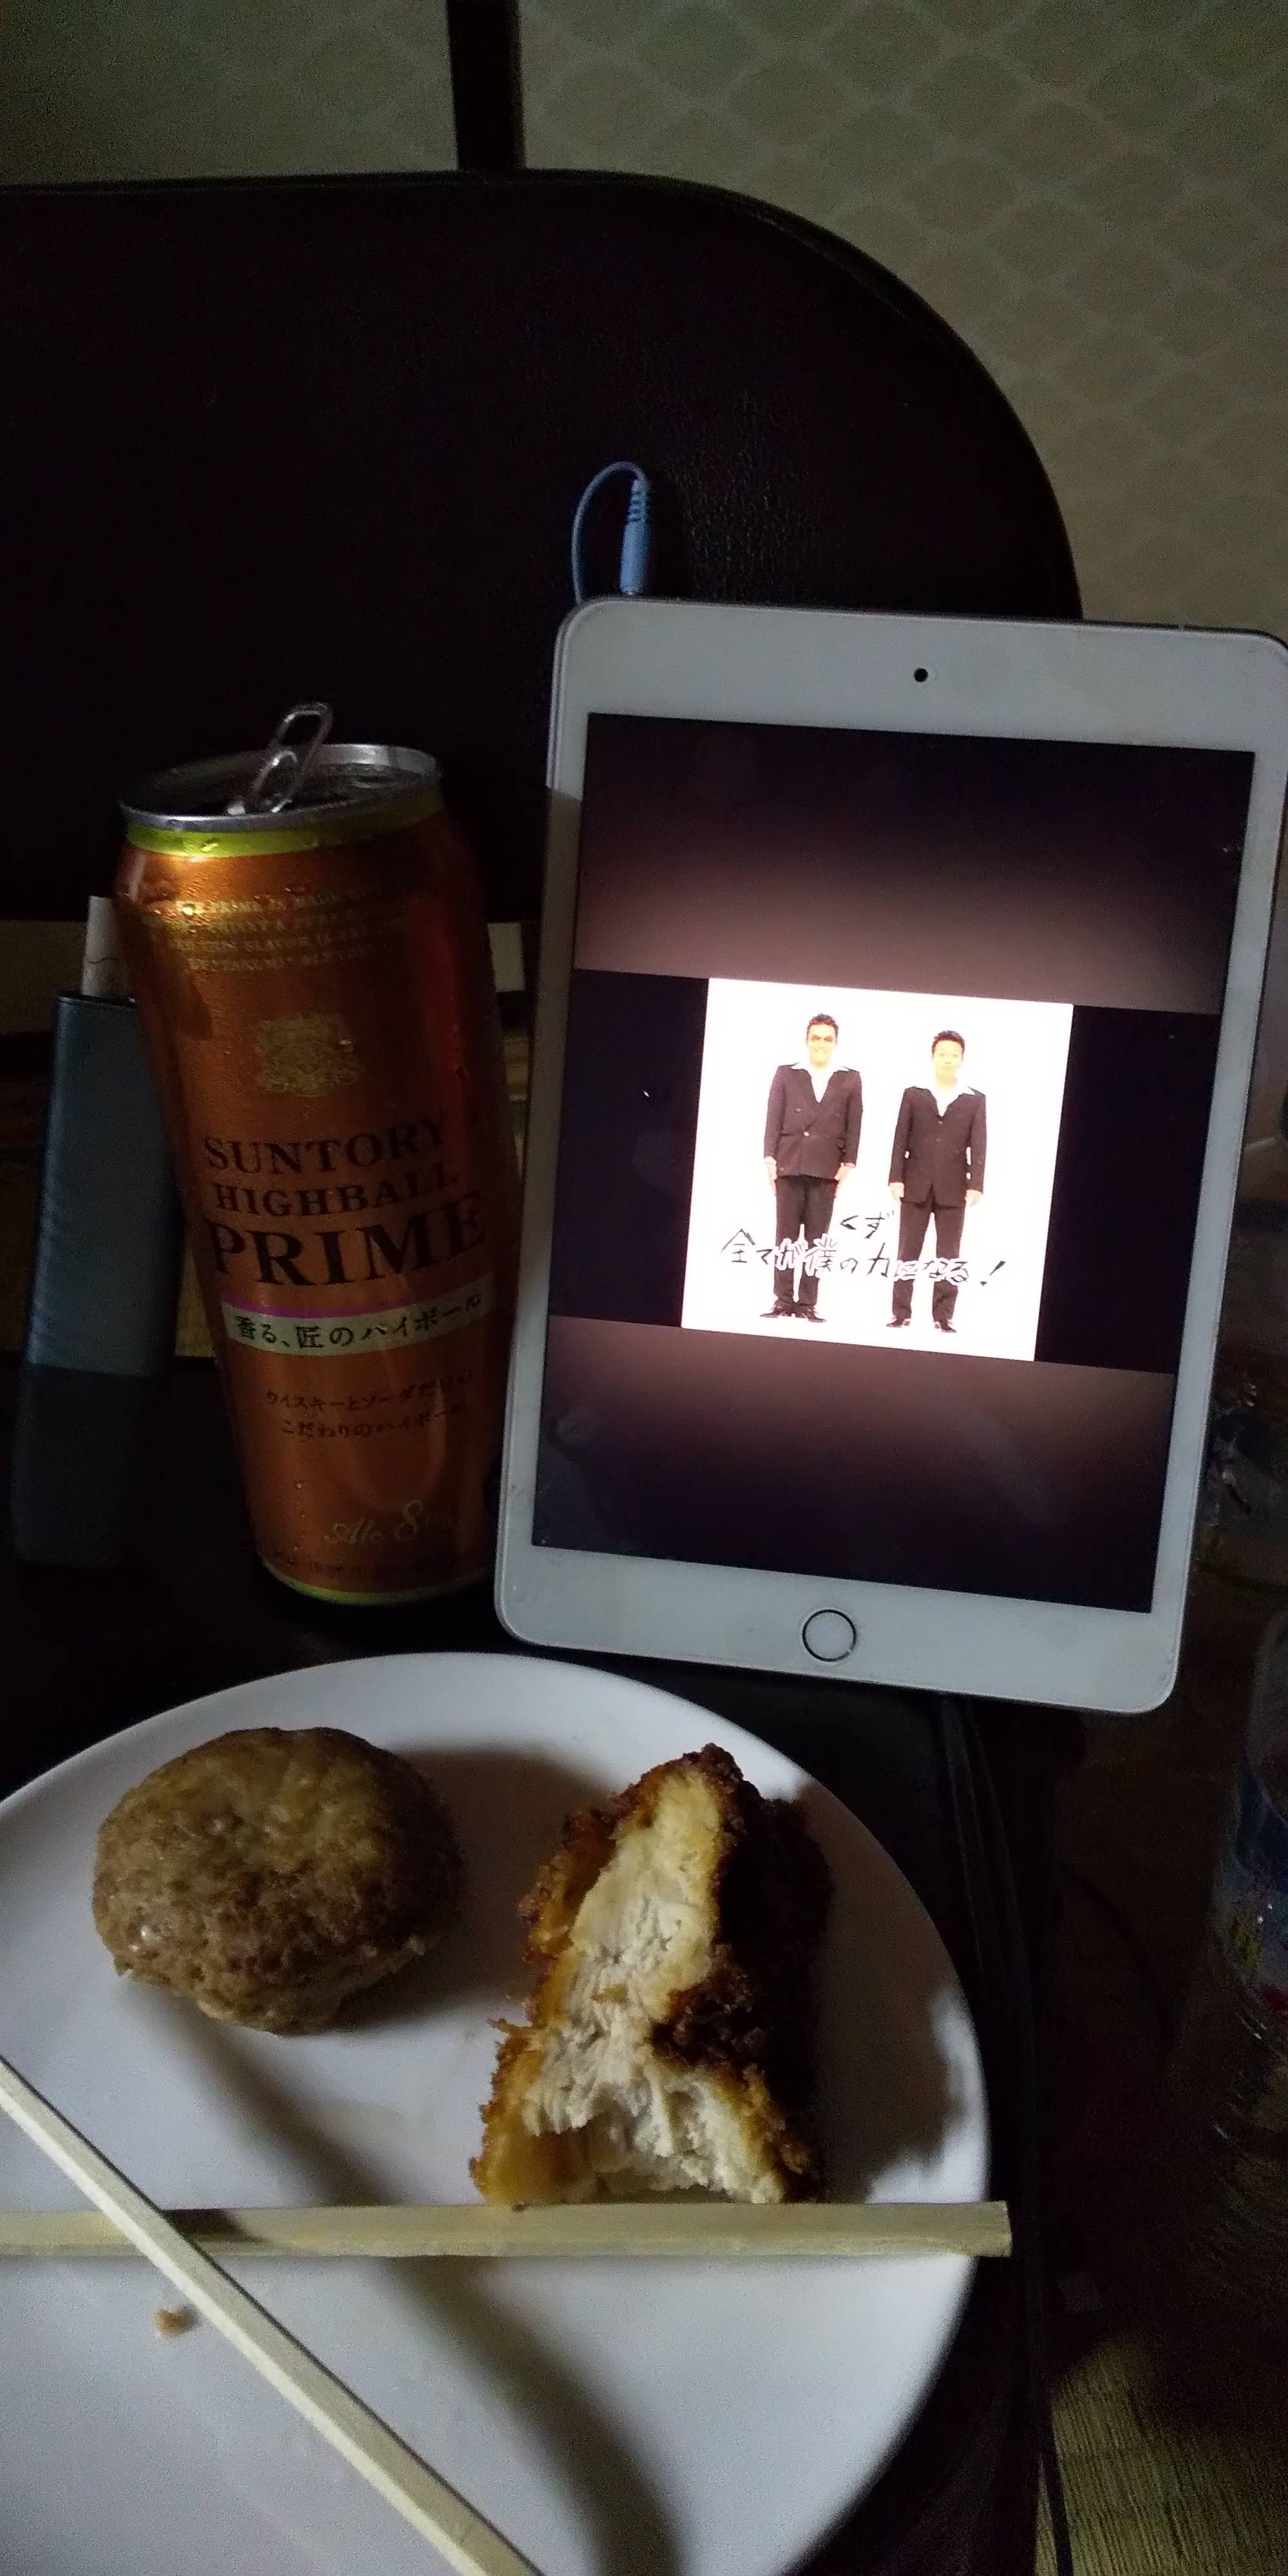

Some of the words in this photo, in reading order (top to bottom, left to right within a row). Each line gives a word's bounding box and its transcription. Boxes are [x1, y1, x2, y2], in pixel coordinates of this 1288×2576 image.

[204, 1113, 448, 1175] SUNTORY
[213, 1161, 460, 1217] HIGHBALL
[204, 1190, 486, 1286] PRIME
[235, 1295, 482, 1349] 香る、匠のハイボール
